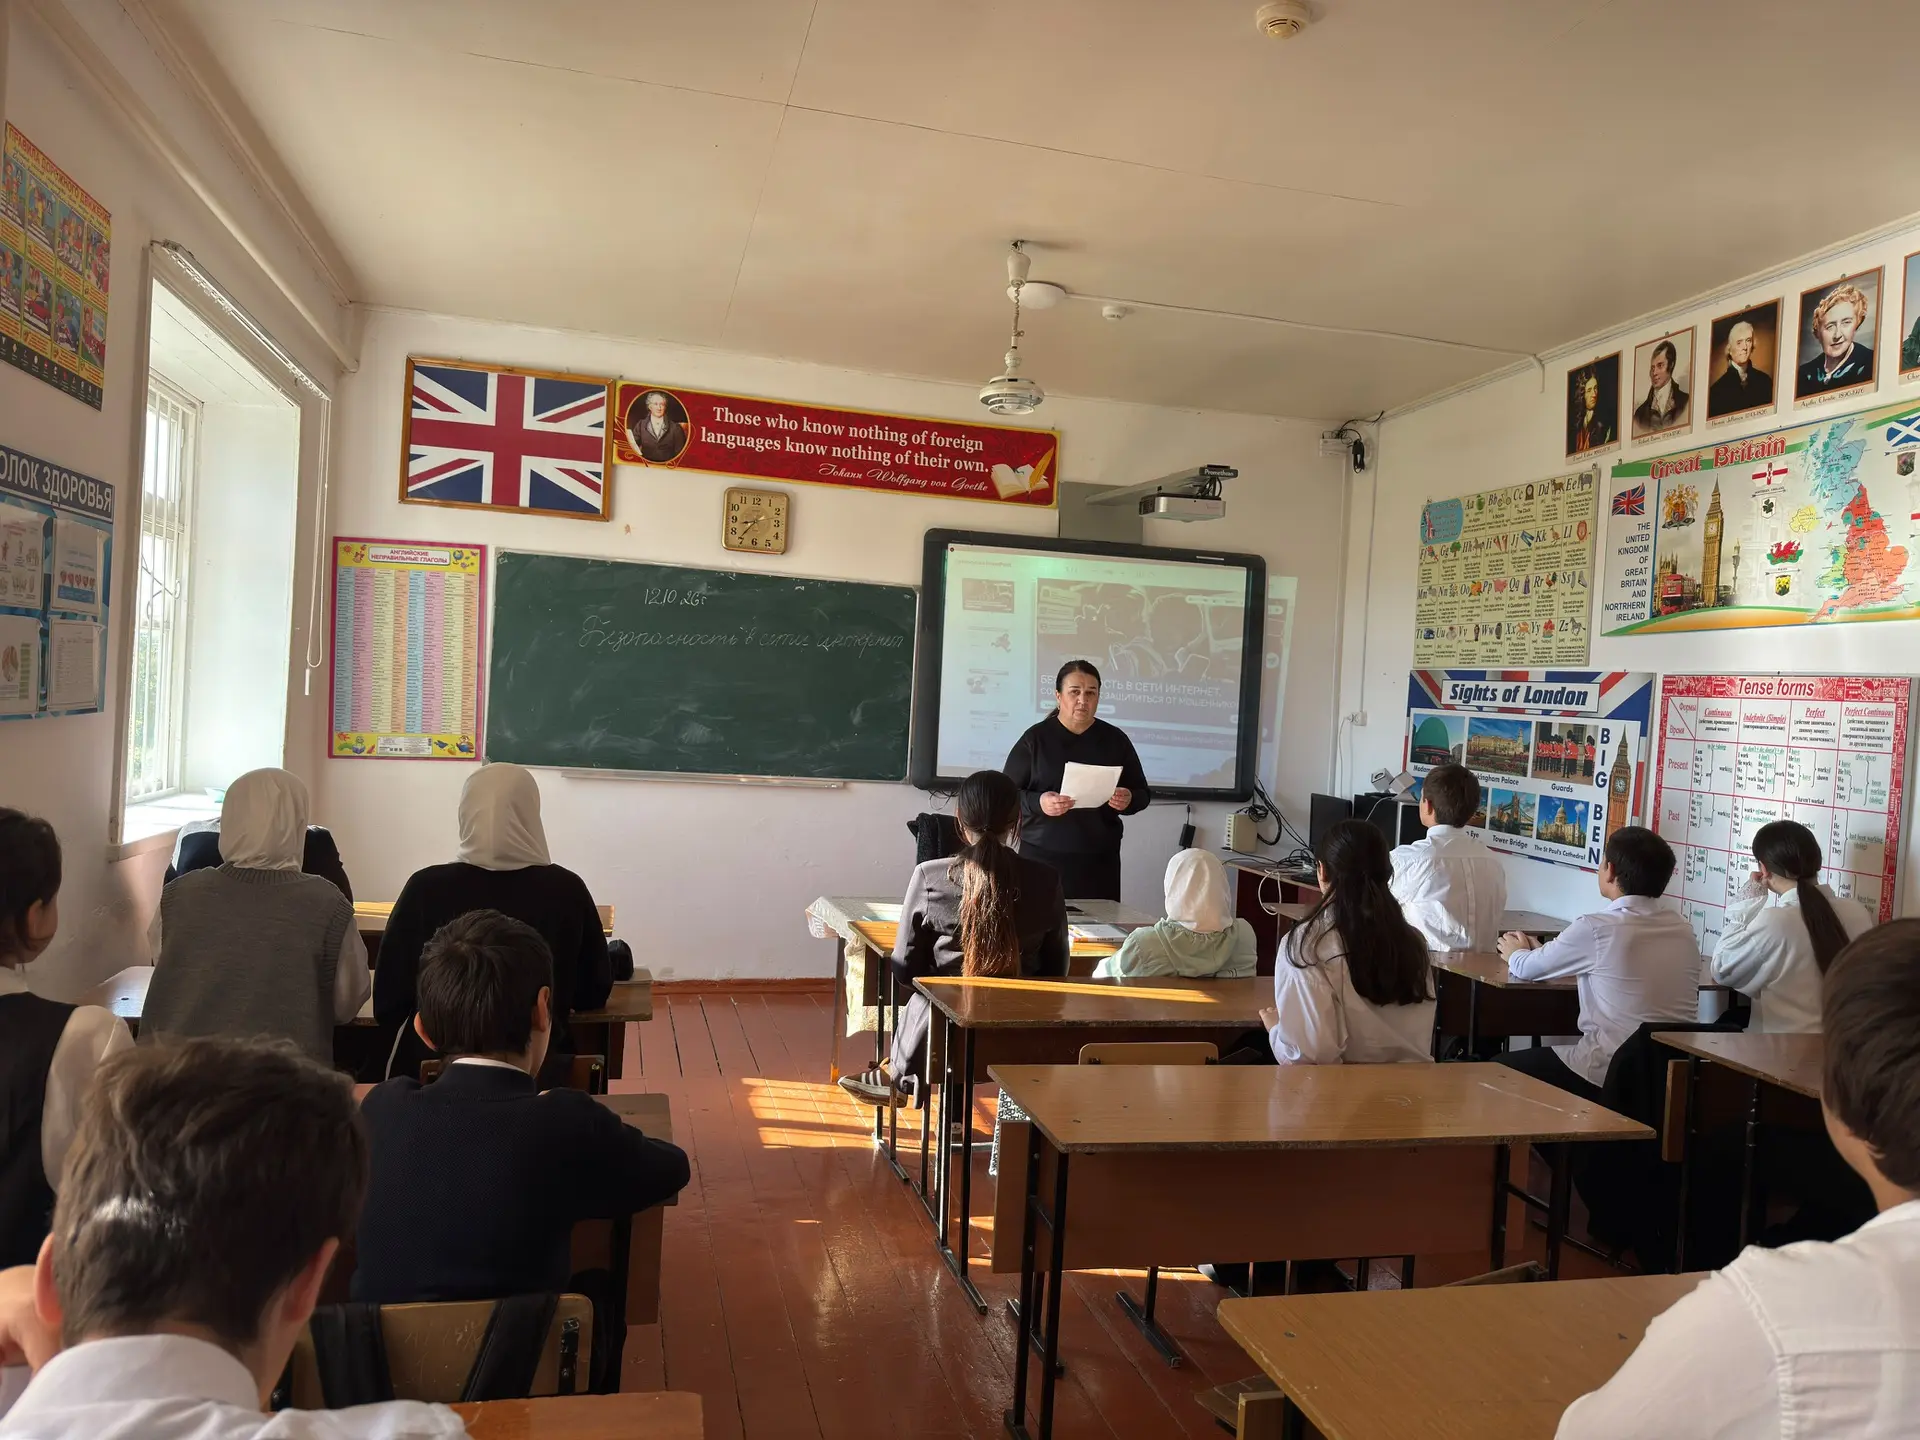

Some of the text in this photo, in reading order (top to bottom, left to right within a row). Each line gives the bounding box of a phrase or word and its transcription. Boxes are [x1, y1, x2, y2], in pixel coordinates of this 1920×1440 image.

[713, 406, 984, 453] Those who know nothing of foreign
[701, 427, 989, 473] languages know nothing of their own.
[1650, 451, 1702, 480] Great
[1713, 433, 1787, 469] Britain
[818, 463, 989, 492] Johann Wolfgang von Goethe
[42, 466, 112, 512] ЗДОРОВЬЯ
[740, 496, 772, 507] 11 12 1
[1465, 499, 1475, 510] Aa
[1513, 488, 1524, 501] Cc
[1538, 482, 1550, 497] Dd
[731, 503, 780, 516] 10 2
[731, 515, 780, 528] 9 3
[1637, 522, 1651, 531] THE
[730, 527, 779, 540] 8 4
[1511, 534, 1519, 548] Jj
[1535, 531, 1547, 543] Kk
[1563, 526, 1572, 539] Ll
[1625, 533, 1650, 544] UNITED
[738, 536, 771, 547] 7 6 5
[390, 549, 429, 557] АНГЛИЙСКИЕ
[1617, 545, 1650, 555] KINGDOM
[371, 554, 419, 562] НЕПРАВИЛЬНЫЕ
[1639, 556, 1648, 564] OF
[1625, 567, 1648, 576] GREAT
[1460, 584, 1470, 594] Oo
[1482, 581, 1492, 594] Pp
[1509, 577, 1520, 592] Qq
[1533, 575, 1544, 588] Rr
[1561, 572, 1571, 584] Ss
[1621, 579, 1647, 588] BRITAIN
[1632, 590, 1646, 598] AND
[1605, 601, 1646, 611] NORTRHERN
[1616, 612, 1645, 621] IRELAND
[578, 615, 739, 652] Безопасность
[1481, 624, 1494, 636] Ww
[1505, 622, 1516, 635] Xx
[1531, 621, 1541, 639] Yy
[1558, 620, 1569, 632] Zz
[1126, 681, 1133, 690] В
[1135, 682, 1164, 693] СЕТИ
[1739, 678, 1815, 696] Tense forms
[1105, 692, 1164, 704] ЗАЩИТИТЬСЯ
[1166, 697, 1177, 705] ОТ
[1450, 684, 1589, 706] Sights of London
[1679, 702, 1697, 712] Формы
[1704, 707, 1732, 718] Continuous
[1805, 707, 1826, 719] Perfect
[1844, 707, 1894, 718] Perfect Continuous
[1743, 712, 1787, 724] Indefinite (Simple)
[1669, 725, 1685, 736] Время
[1668, 758, 1689, 770] Present
[1501, 777, 1519, 786] Palace
[1551, 783, 1573, 793] Guards
[1668, 809, 1680, 821] Past
[1470, 831, 1480, 839] Eye
[1492, 835, 1528, 849] Tower Bridge
[1534, 844, 1543, 852] The
[1548, 847, 1562, 857] Paul's
[1562, 850, 1586, 860] Cathedral
[1832, 847, 1841, 855] They
